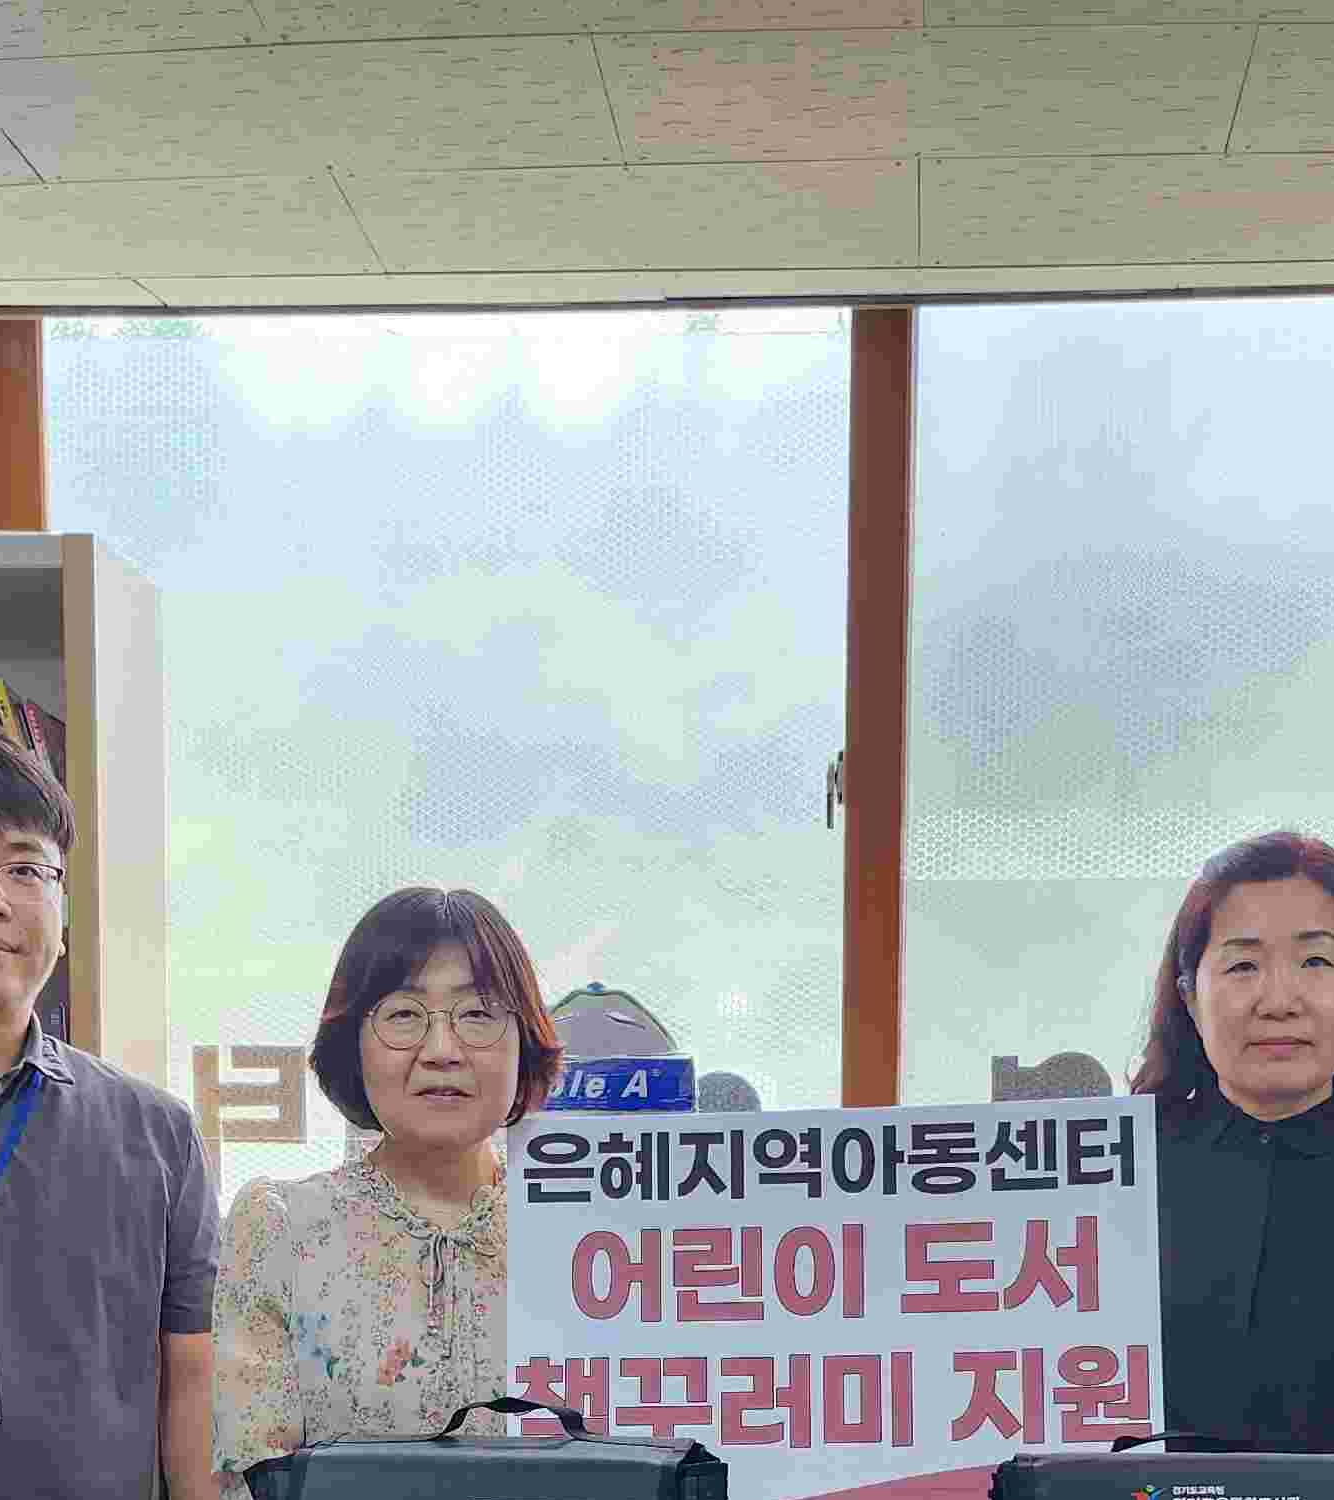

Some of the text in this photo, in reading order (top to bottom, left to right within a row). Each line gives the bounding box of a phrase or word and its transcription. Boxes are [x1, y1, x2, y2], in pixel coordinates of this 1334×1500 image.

[621, 1069, 649, 1098] A
[523, 1116, 1136, 1204] 은혜지역아동센터
[570, 1215, 1100, 1323] 어린이 도서
[514, 1345, 1153, 1449] 책꾸러미 지원
